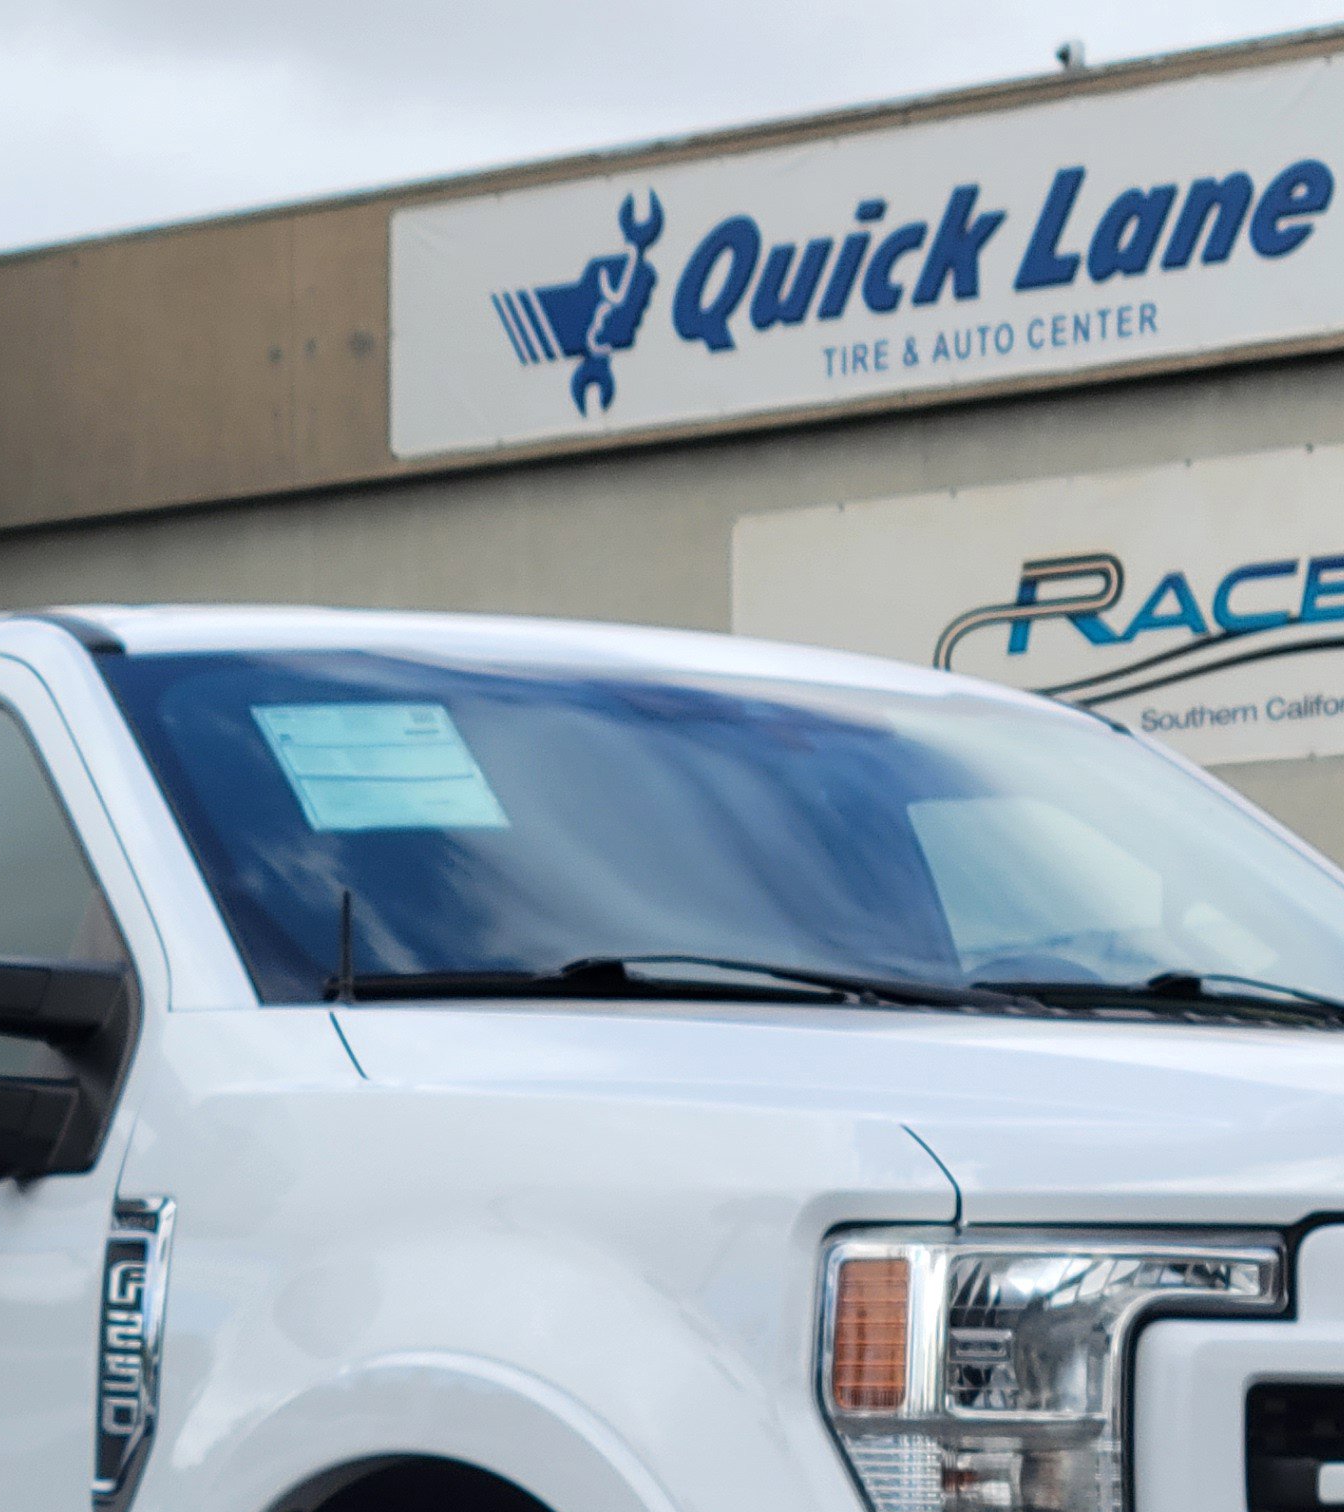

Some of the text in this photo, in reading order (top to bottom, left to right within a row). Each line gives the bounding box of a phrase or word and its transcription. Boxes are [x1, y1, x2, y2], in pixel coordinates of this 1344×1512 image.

[671, 157, 1336, 355] Quick Lane
[823, 302, 1159, 377] TIRE & AUTO CENTER
[1140, 703, 1258, 734] Southern
